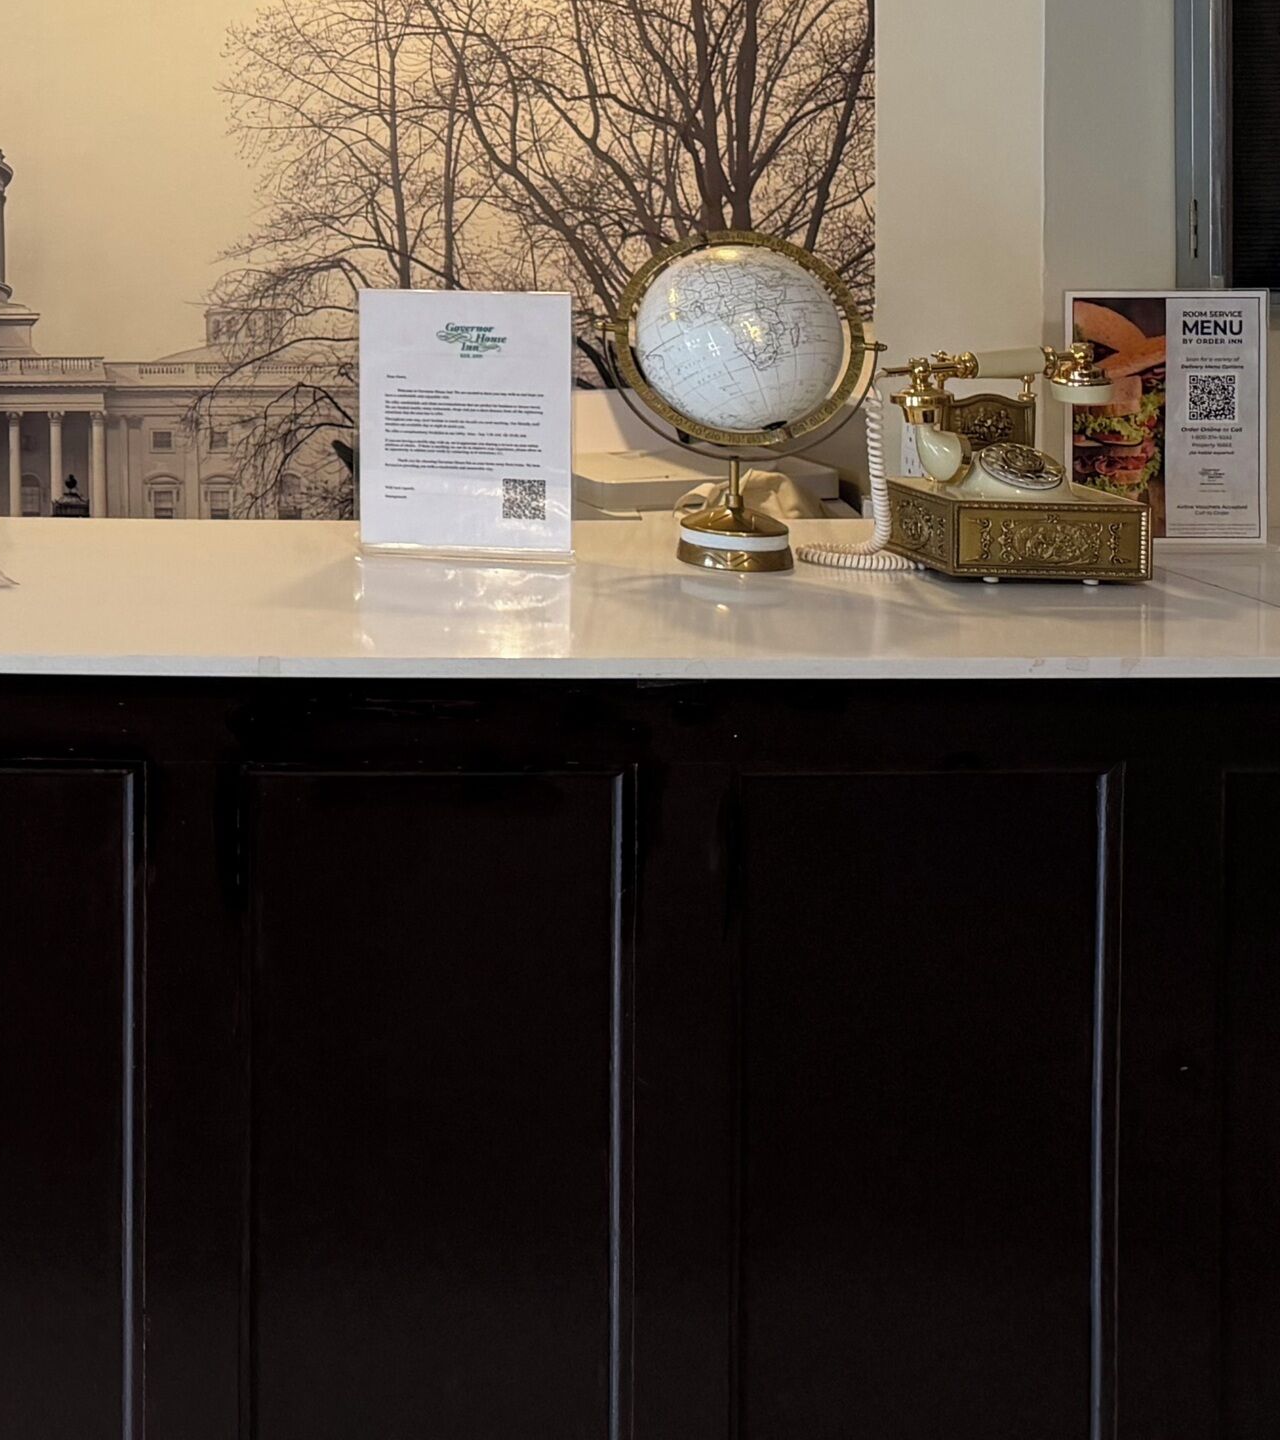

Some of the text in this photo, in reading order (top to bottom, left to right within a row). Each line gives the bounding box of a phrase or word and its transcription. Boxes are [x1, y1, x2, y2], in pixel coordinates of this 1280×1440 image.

[1182, 310, 1243, 318] ROOM SERVICE
[444, 322, 495, 333] Governor
[1182, 319, 1243, 336] MENU
[475, 333, 508, 344] House
[460, 341, 479, 352] Inn
